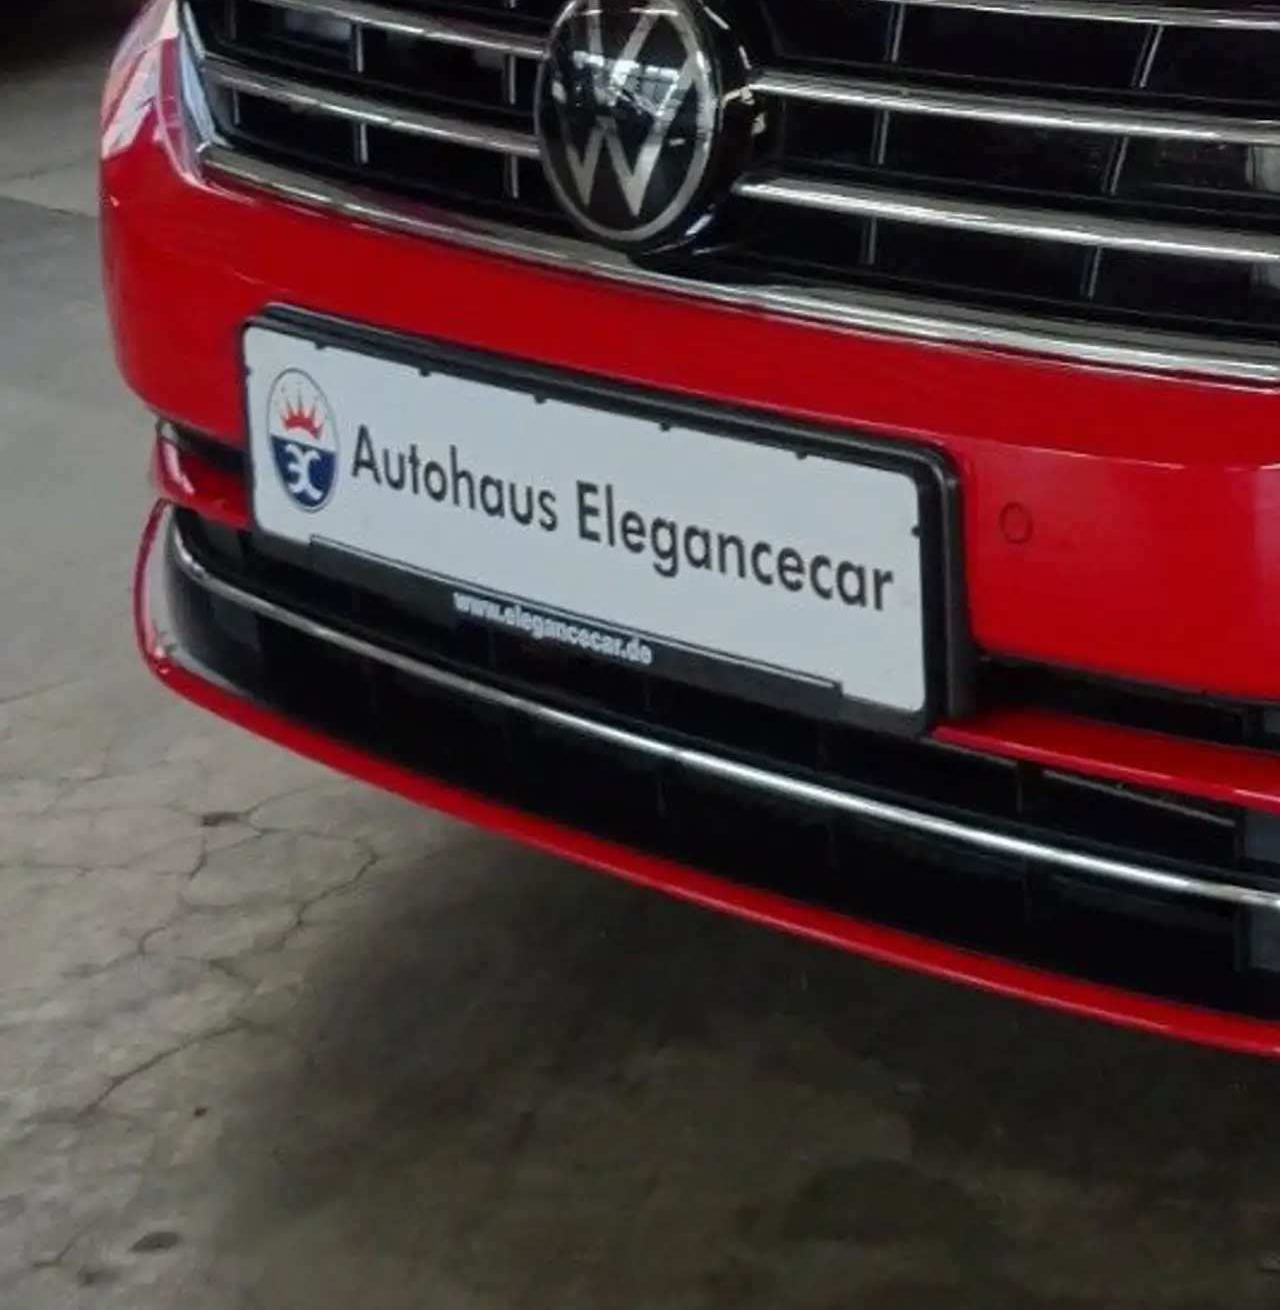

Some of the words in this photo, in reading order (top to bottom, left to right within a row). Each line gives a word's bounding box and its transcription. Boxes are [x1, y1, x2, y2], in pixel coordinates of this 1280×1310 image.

[352, 423, 558, 532] Autohaus
[577, 480, 893, 611] Elegancecar
[453, 591, 652, 665] www.elegancecar.de
